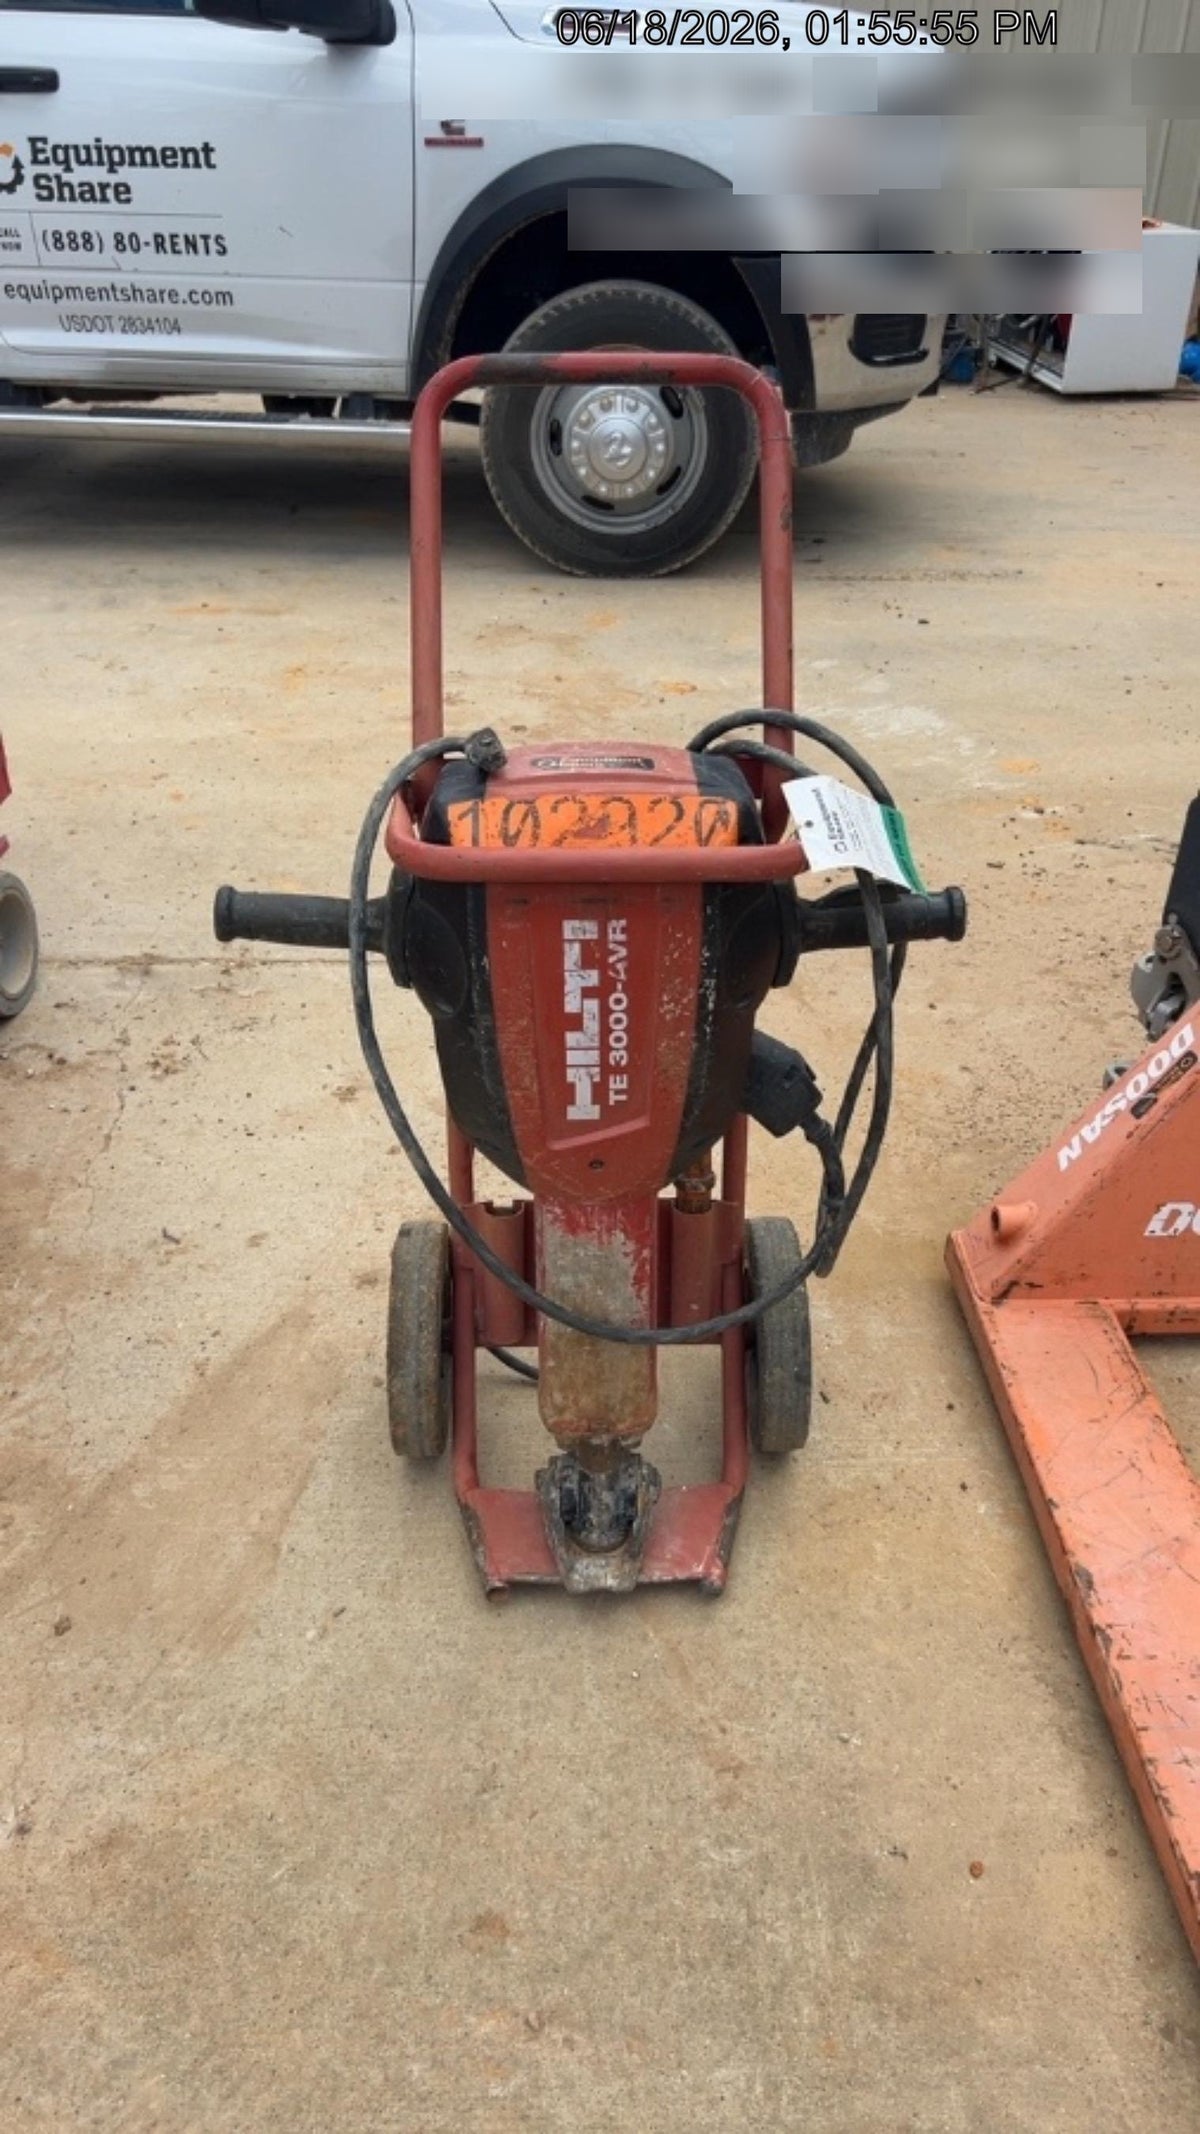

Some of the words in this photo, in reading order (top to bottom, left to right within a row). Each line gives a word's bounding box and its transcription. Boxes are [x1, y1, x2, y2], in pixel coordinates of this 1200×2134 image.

[27, 136, 217, 173] Equipment
[32, 172, 132, 204] Share
[42, 229, 104, 254] (888)
[113, 232, 229, 256] 80-RENTS
[4, 279, 235, 306] equipmentshare.com
[59, 314, 114, 333] USDOT
[119, 316, 182, 335] 2834104
[607, 918, 630, 1067] 3000-AVR
[562, 919, 601, 1121] HILTI
[609, 1073, 630, 1106] TE
[1056, 1022, 1197, 1172] DOOSAN
